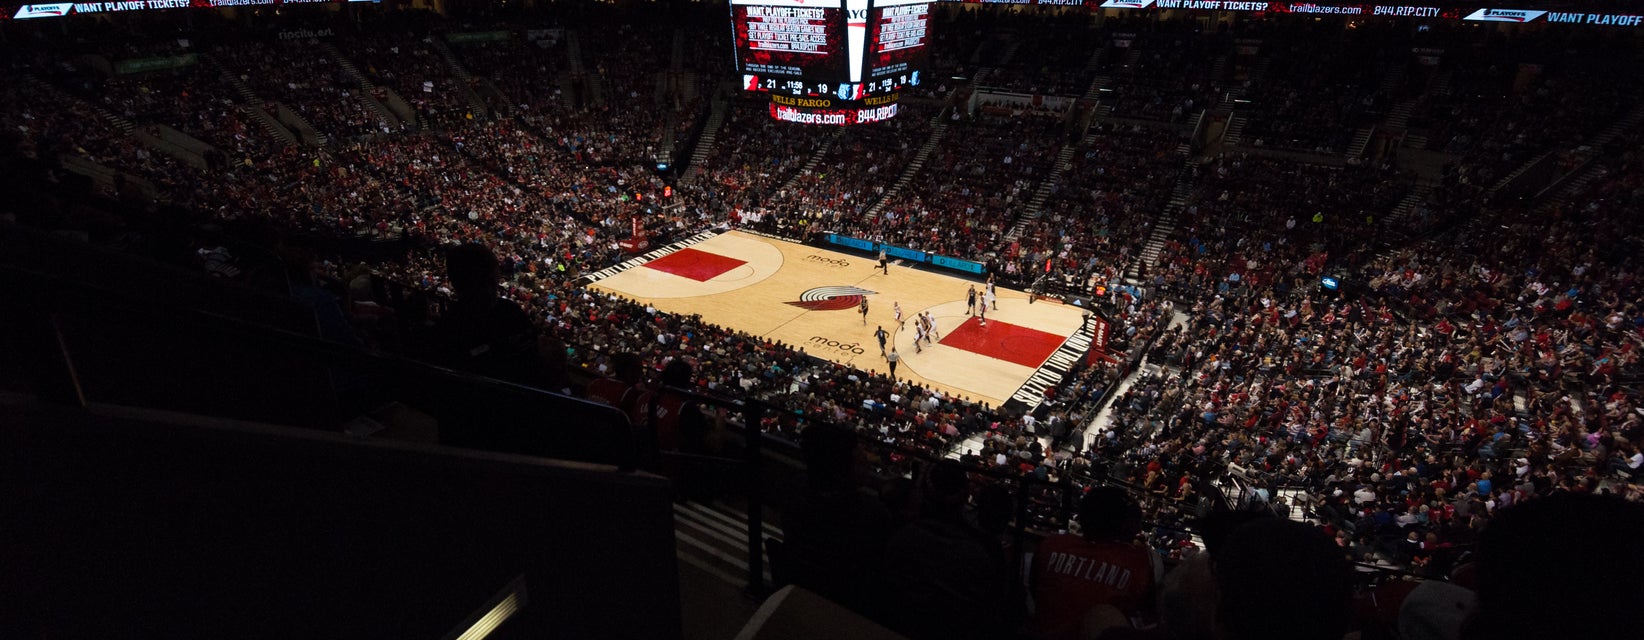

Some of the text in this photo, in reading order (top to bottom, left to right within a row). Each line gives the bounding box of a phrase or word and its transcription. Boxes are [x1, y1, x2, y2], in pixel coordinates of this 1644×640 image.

[74, 0, 190, 13] WANT PLAYOFF TICKETS?
[747, 6, 764, 17] WANT
[1156, 0, 1269, 12] WANT PLAYOFF TICKETS?
[1290, 4, 1441, 18] trailblazers.com 844.RIP.CITY
[1548, 12, 1644, 27] WANT PLAYOFF
[767, 79, 777, 89] 21
[818, 83, 829, 94] 19
[869, 82, 877, 92] 21
[900, 75, 907, 86] 19
[798, 97, 832, 108] FARGO
[864, 96, 891, 107] WELLS
[777, 107, 846, 125] trailblazers.com
[586, 256, 648, 283] PORTLAND
[644, 242, 677, 263] TRAIL
[674, 229, 718, 251] BLAZERS
[807, 254, 850, 267] moda
[809, 336, 865, 355] moda
[1044, 347, 1084, 373] TRAIL
[1012, 366, 1064, 408] BLAZERS
[1046, 551, 1132, 591] PORTLAND
